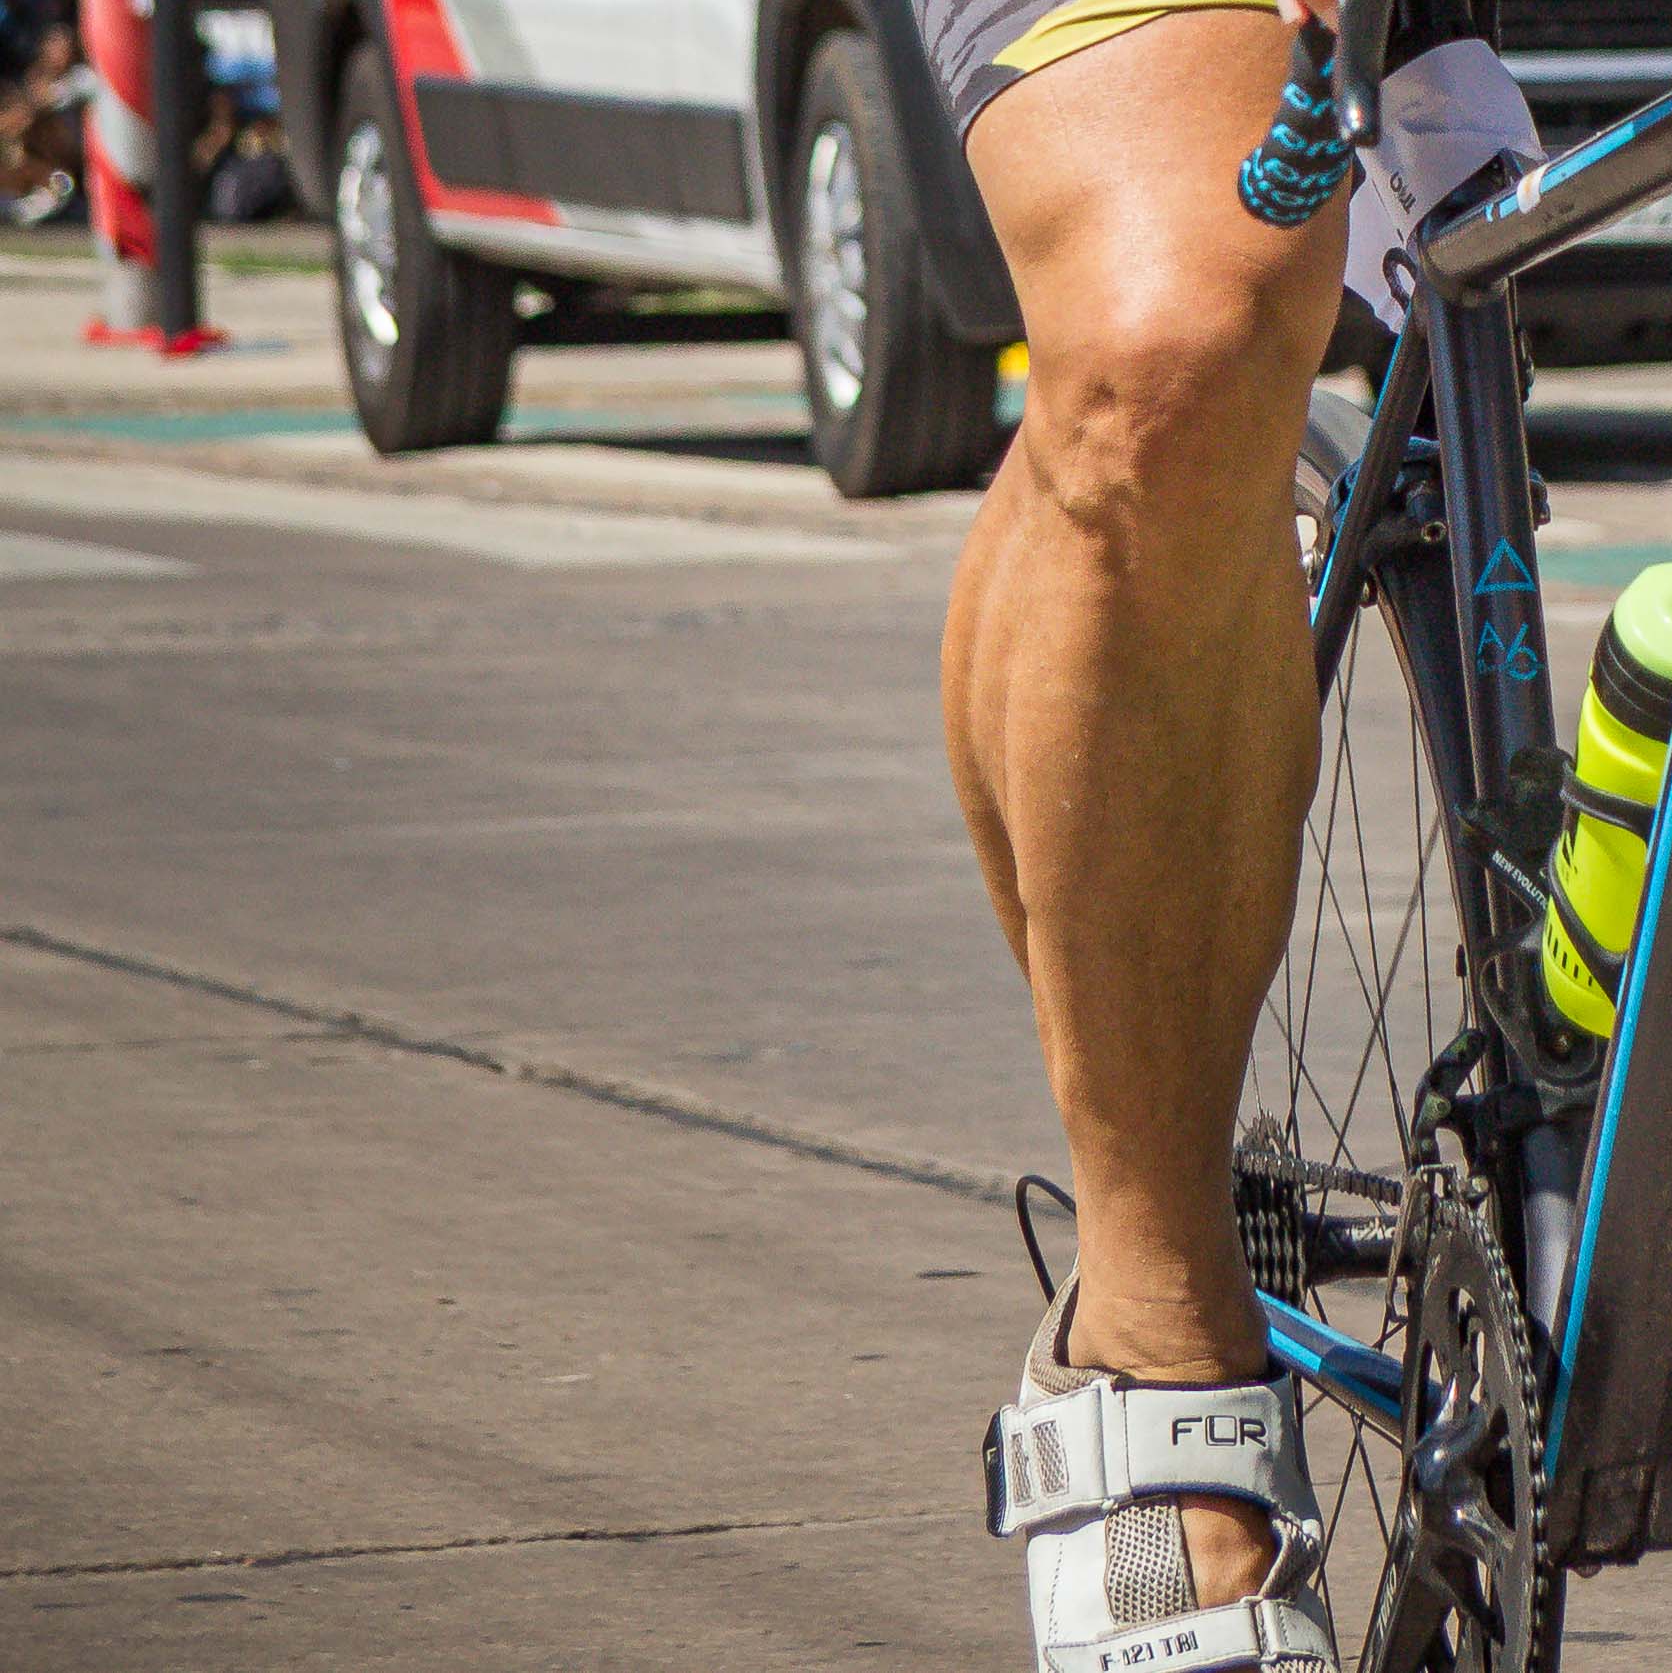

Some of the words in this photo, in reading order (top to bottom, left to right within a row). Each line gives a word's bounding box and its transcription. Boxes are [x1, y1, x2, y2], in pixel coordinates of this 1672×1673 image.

[1491, 850, 1515, 873] NEW
[1172, 1415, 1267, 1447] FLR
[1159, 1630, 1199, 1658] TRI
